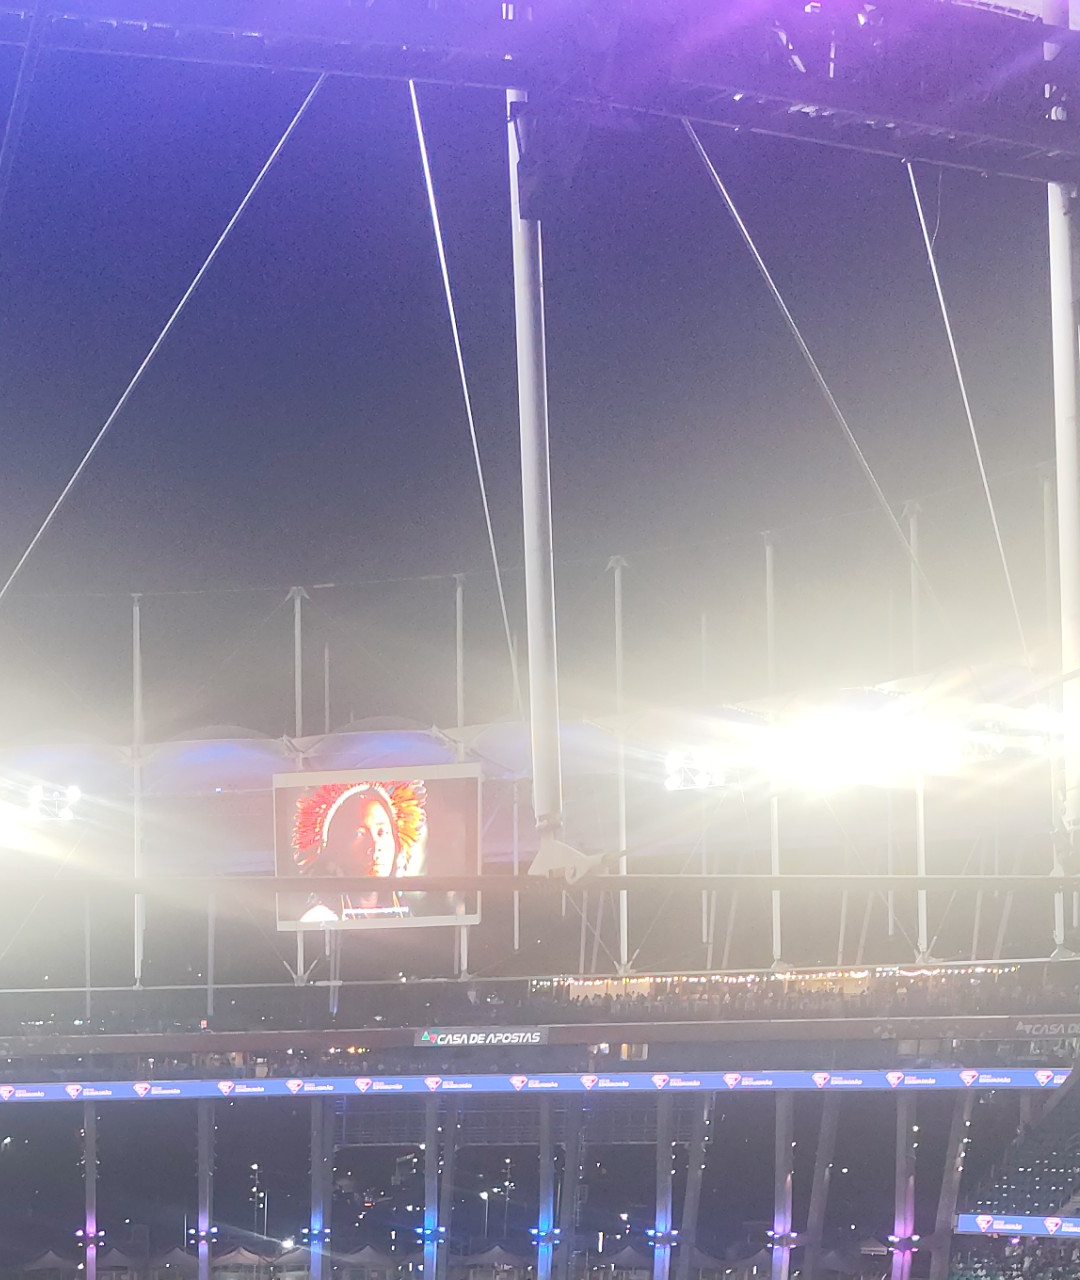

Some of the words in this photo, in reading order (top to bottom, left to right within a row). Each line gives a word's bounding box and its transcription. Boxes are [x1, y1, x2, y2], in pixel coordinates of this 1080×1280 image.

[1032, 1024, 1065, 1035] CASA
[436, 1033, 468, 1044] CASA
[469, 1033, 485, 1044] DE
[486, 1032, 540, 1043] APOSTAS
